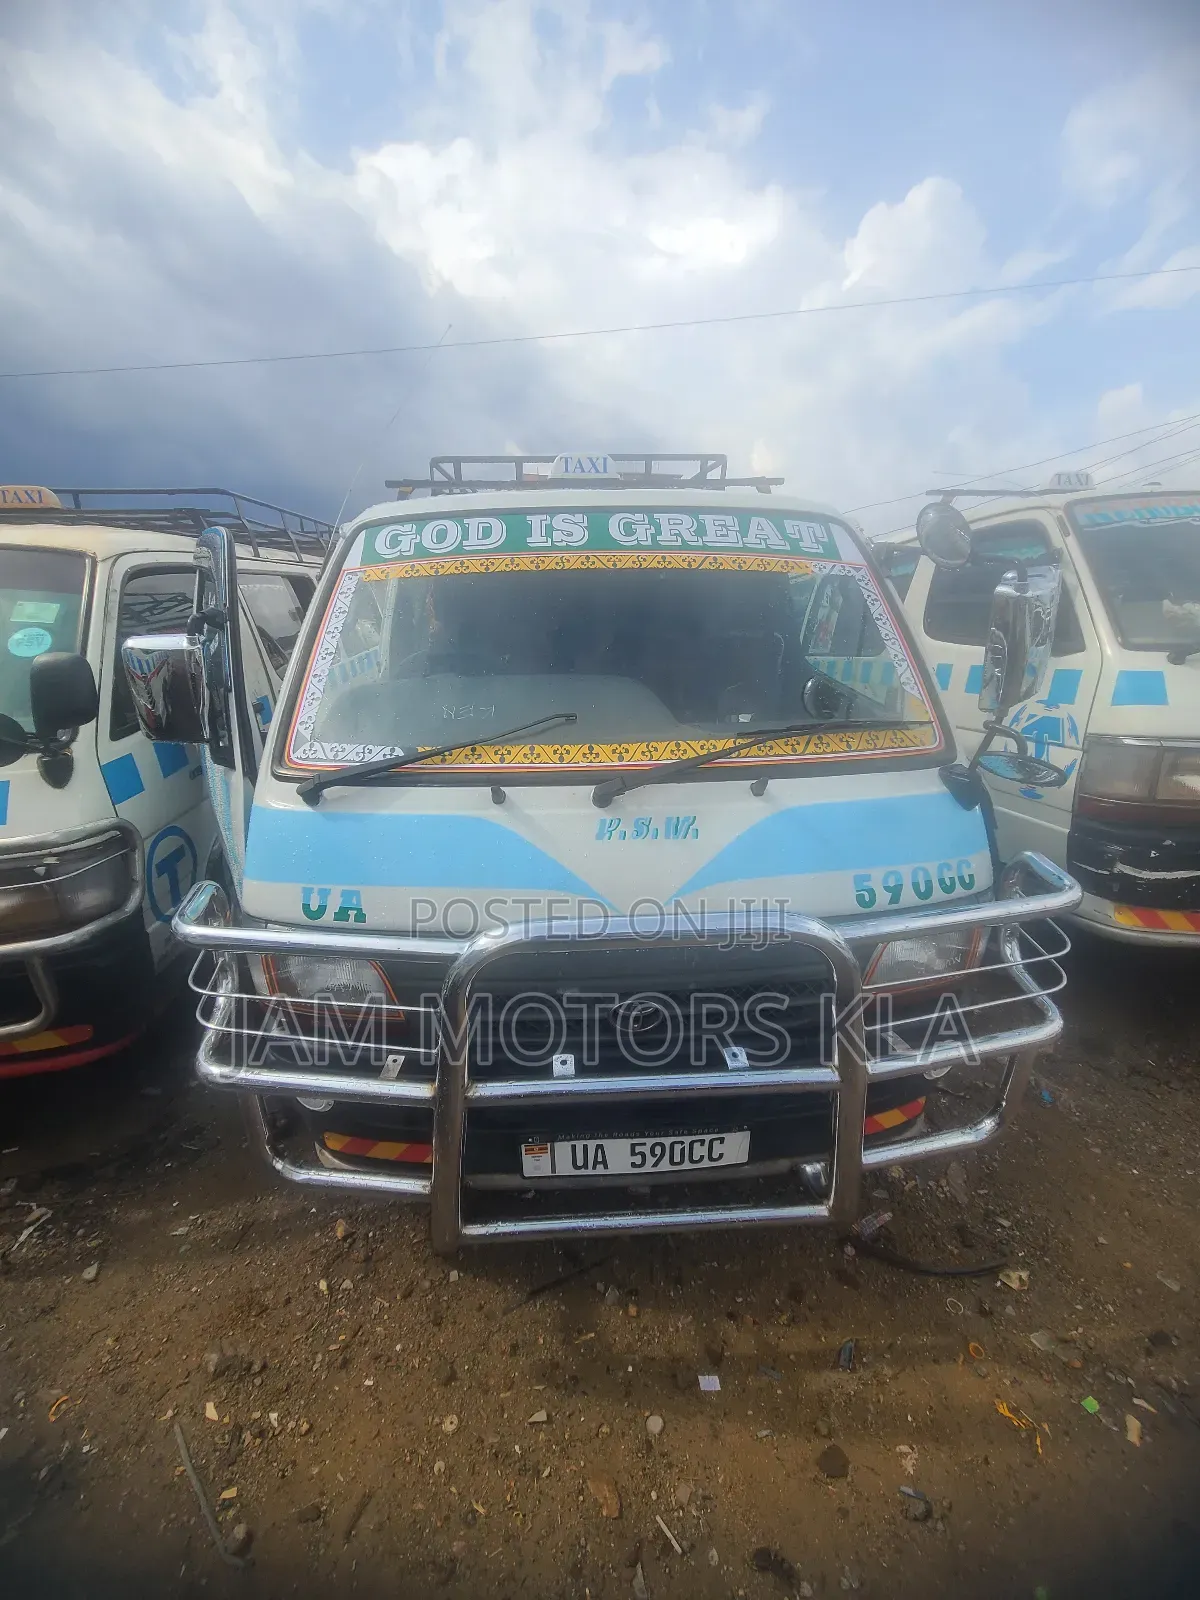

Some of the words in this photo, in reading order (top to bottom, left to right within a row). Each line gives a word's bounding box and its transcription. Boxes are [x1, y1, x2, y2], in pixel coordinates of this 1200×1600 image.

[560, 457, 608, 474] TAXI
[1055, 473, 1090, 486] TAXI
[0, 490, 44, 504] TAXI
[375, 516, 507, 559] GOD
[526, 513, 589, 547] IS
[608, 512, 828, 554] GREAT
[301, 886, 367, 924] UA
[853, 859, 976, 909] 590CC
[571, 1143, 609, 1170] UA
[630, 1136, 726, 1169] 590CC
